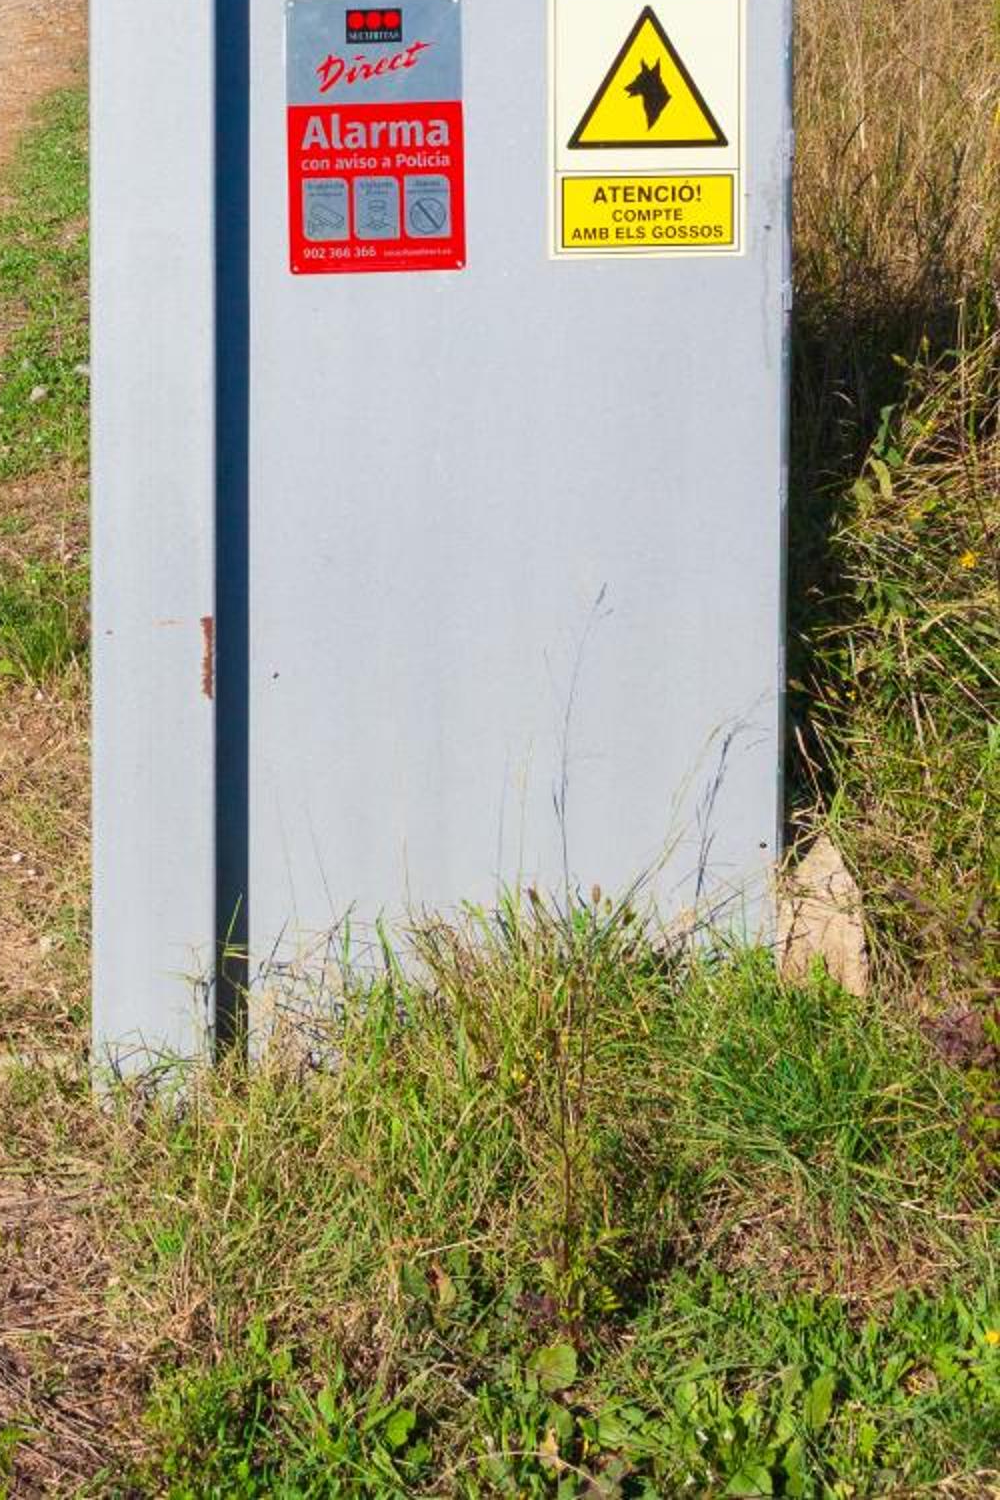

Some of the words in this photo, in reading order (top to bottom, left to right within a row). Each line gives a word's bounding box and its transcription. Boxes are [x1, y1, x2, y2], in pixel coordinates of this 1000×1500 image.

[316, 41, 434, 94] Direct
[301, 113, 450, 151] Alarma
[301, 158, 330, 171] con
[335, 153, 377, 170] aviso
[381, 158, 392, 168] a
[593, 180, 702, 204] ATENCIÓ!
[612, 208, 683, 223] COMPTE
[571, 227, 610, 241] AMB
[615, 226, 646, 240] ELS
[653, 225, 724, 239] GOSSOS
[303, 247, 326, 259] 902
